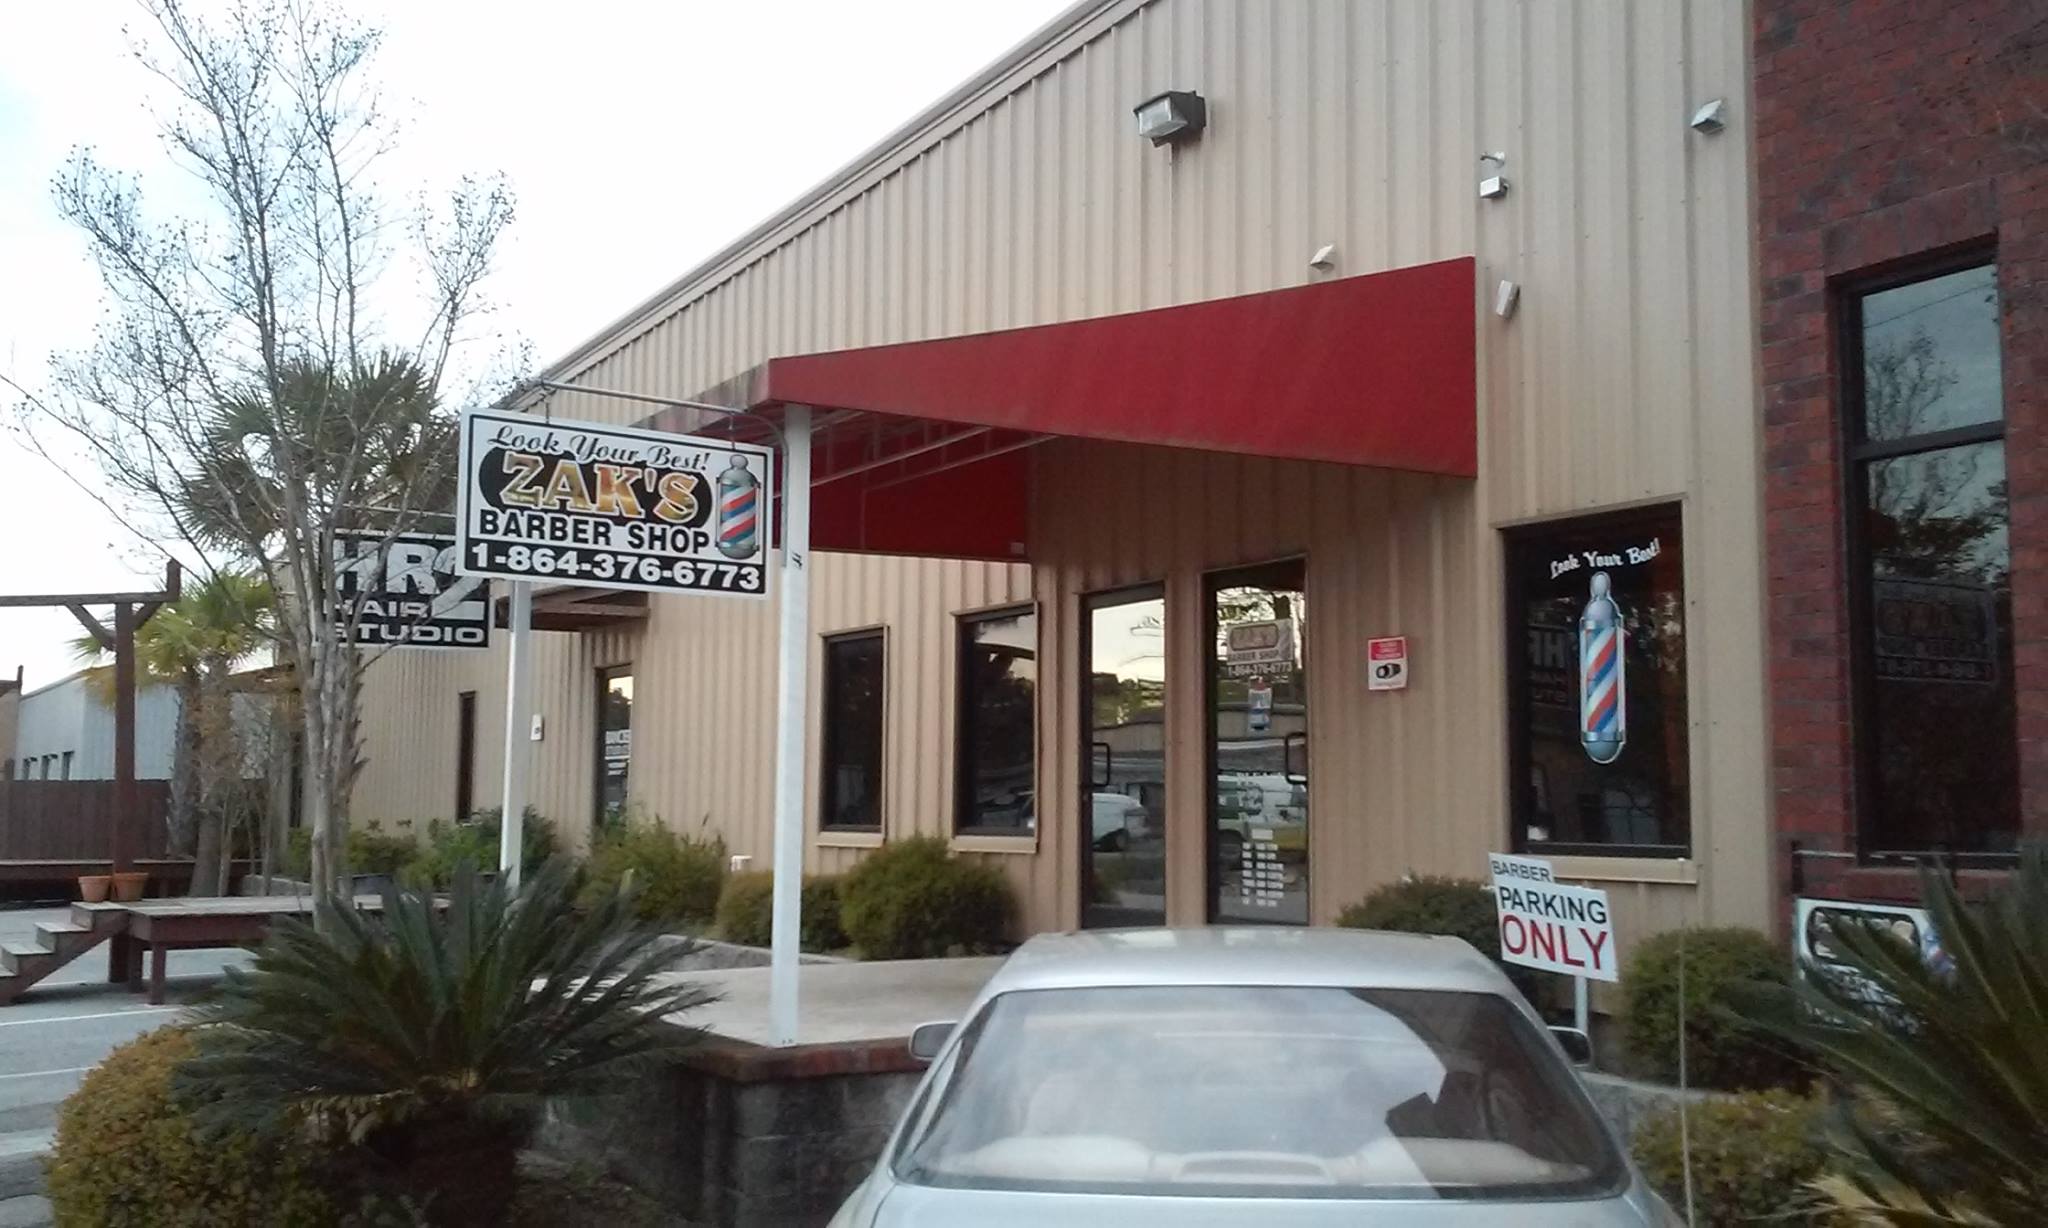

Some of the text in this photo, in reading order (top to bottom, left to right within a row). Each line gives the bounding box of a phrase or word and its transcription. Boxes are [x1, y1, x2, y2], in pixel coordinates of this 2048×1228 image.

[487, 425, 711, 470] Look Your Best!
[499, 451, 699, 524] ZAK'S
[479, 508, 711, 555] BARBER SHOP
[471, 543, 761, 591] 1-864-376-6773
[1550, 537, 1661, 579] Look Your Best!
[1491, 860, 1551, 882] BARBER
[1499, 886, 1608, 925] PARKING
[1502, 914, 1608, 970] ONLY
